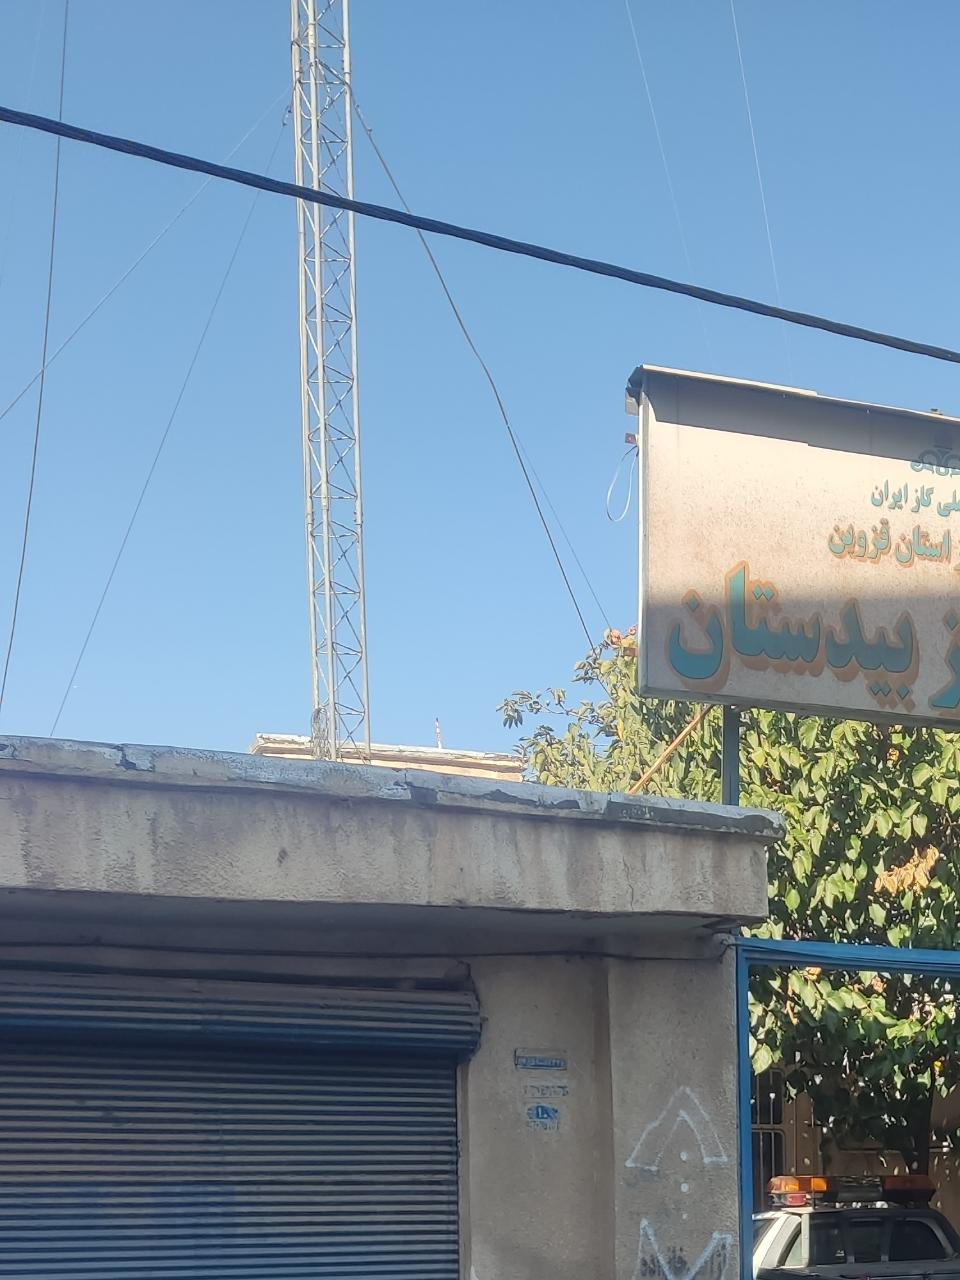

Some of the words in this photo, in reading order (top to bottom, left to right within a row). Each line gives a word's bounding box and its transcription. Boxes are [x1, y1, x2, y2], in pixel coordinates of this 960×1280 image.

[871, 480, 909, 511] ایران
[911, 485, 934, 513] گاز
[828, 518, 892, 563] قزوین
[896, 525, 951, 566] استان
[667, 564, 915, 702] بیدستان
